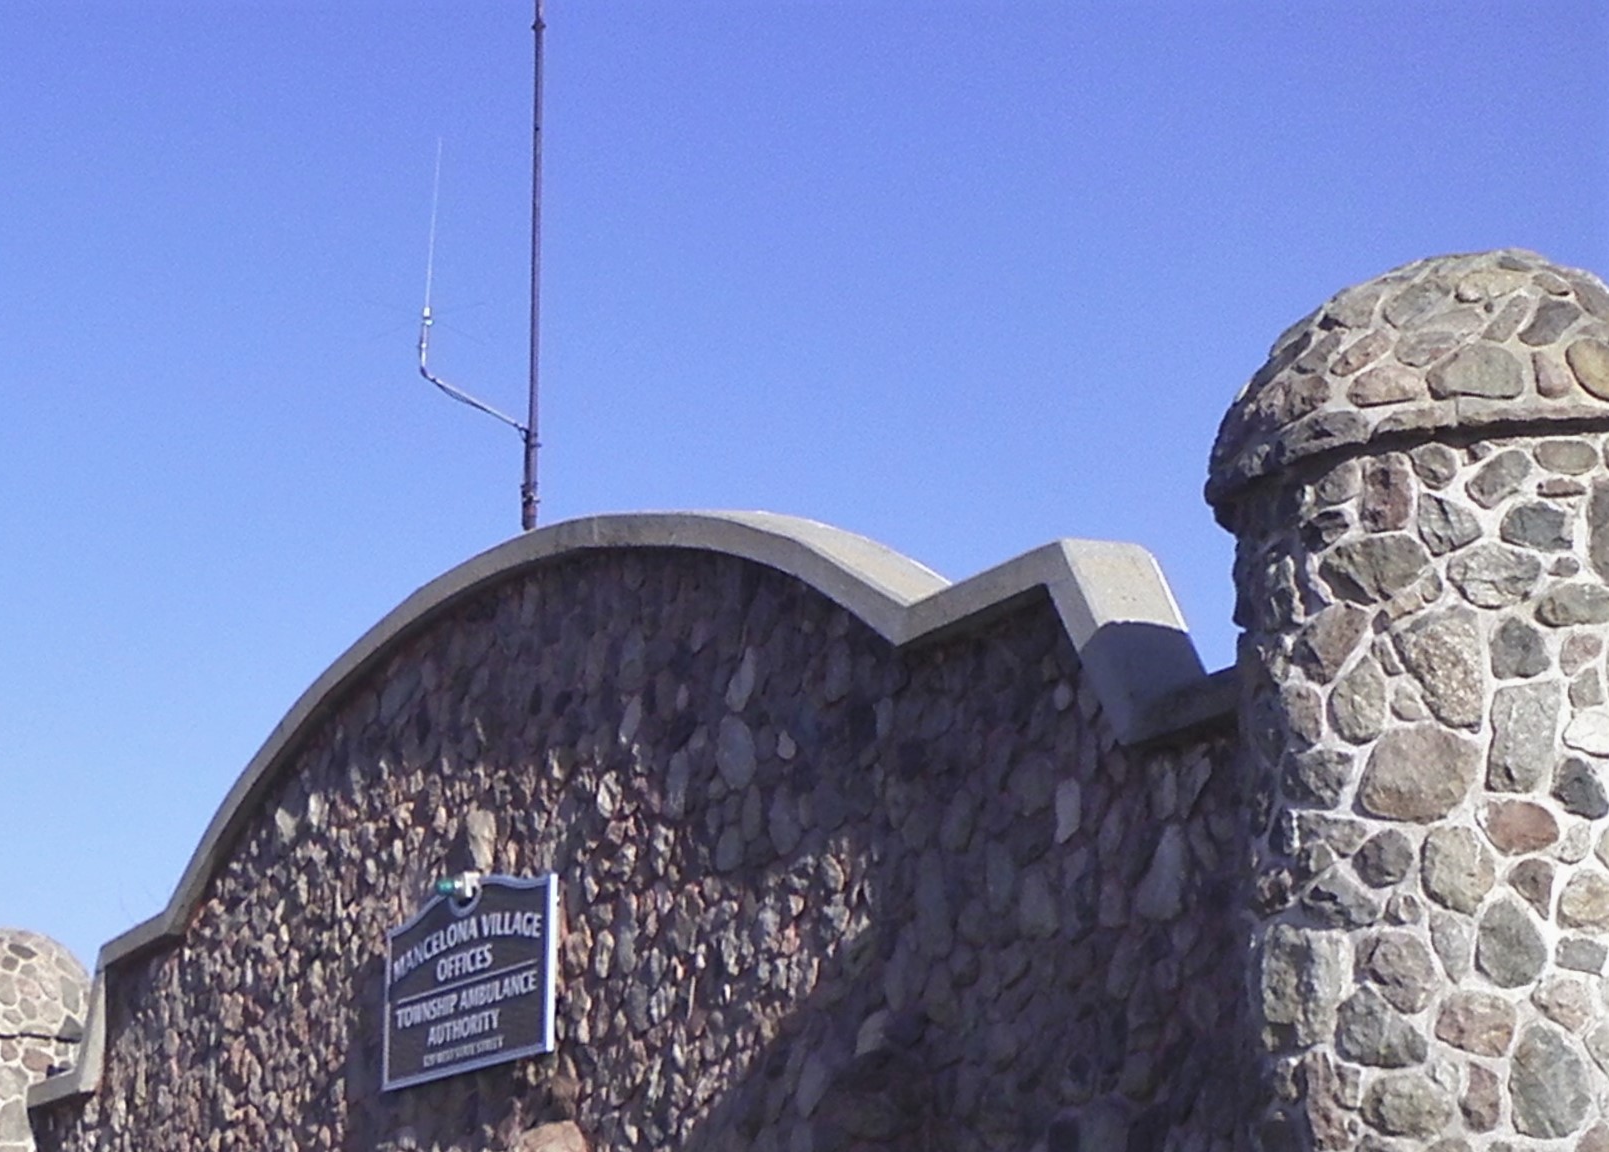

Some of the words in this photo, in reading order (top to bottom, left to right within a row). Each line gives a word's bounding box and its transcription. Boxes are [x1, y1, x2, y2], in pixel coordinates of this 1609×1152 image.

[393, 916, 478, 982] MANCELONA
[480, 911, 542, 938] VILLAGE
[436, 943, 493, 981] OFFICES
[396, 993, 458, 1029] TOWNSHIP
[458, 969, 538, 1011] AMBULANCE
[427, 1008, 500, 1046] AUTHORITY
